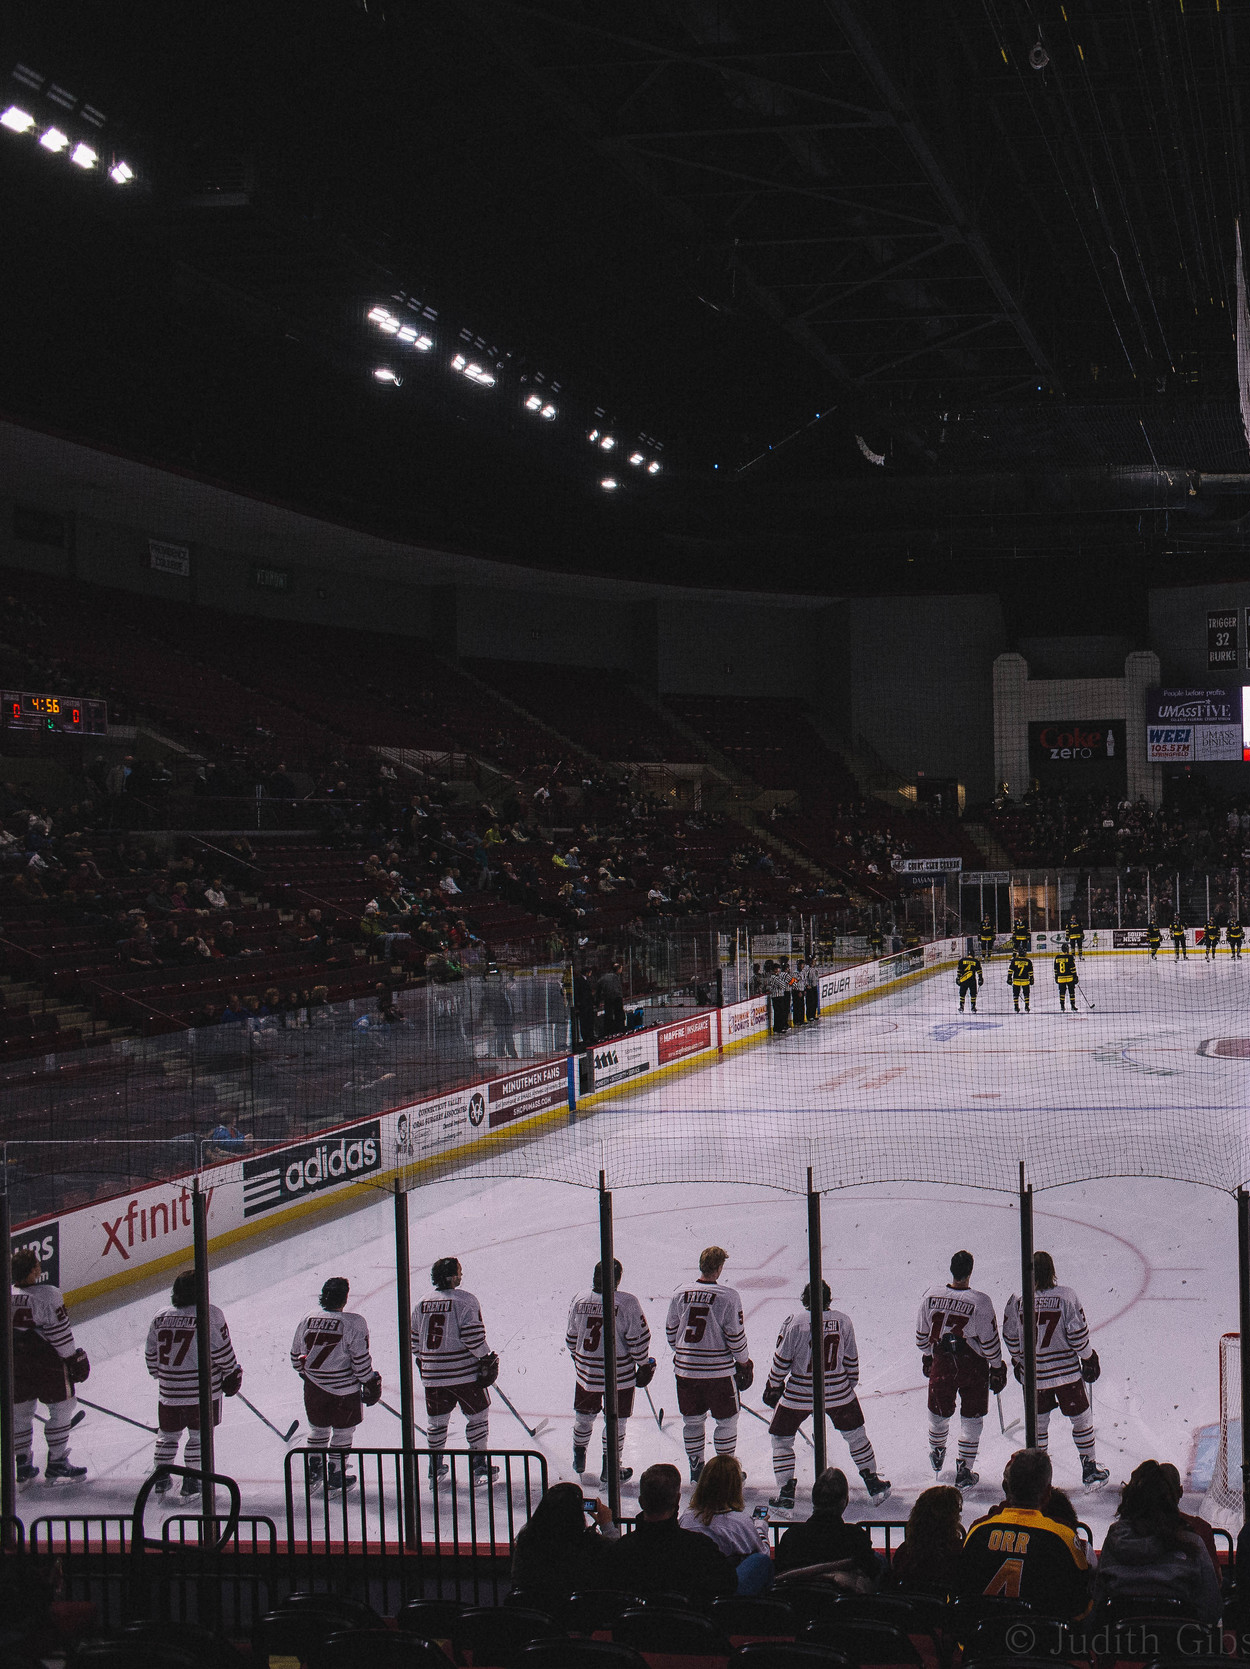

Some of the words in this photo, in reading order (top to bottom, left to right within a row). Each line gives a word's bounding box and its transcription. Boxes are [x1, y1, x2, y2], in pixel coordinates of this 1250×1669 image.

[1208, 617, 1237, 628] TRIGGER
[1215, 633, 1230, 646] 32
[1164, 689, 1184, 697] People
[31, 697, 60, 713] 4:56
[72, 709, 80, 723] 0
[1039, 727, 1101, 749] Coke
[1149, 729, 1191, 743] WEEI
[1202, 731, 1235, 739] UMASS
[1202, 738, 1235, 746] DINING
[1050, 748, 1092, 760] zero
[1151, 744, 1176, 752] 105.5
[1177, 744, 1190, 752] FM
[822, 976, 851, 998] BAUER
[663, 1028, 686, 1044] MAPFRE
[502, 1071, 542, 1096] MINUTEMEN
[543, 1066, 561, 1080] FANS
[513, 1096, 552, 1116] SHOPUMASS.COM
[285, 1137, 377, 1191] adidas
[422, 1300, 450, 1313] TRENTO
[930, 1297, 974, 1315] CHUKAROV
[309, 1318, 337, 1330] KEATS
[426, 1313, 446, 1350] 6
[684, 1306, 710, 1343] 5
[583, 1317, 603, 1352] 3
[157, 1329, 196, 1367] 27
[987, 1530, 1030, 1554] ORR
